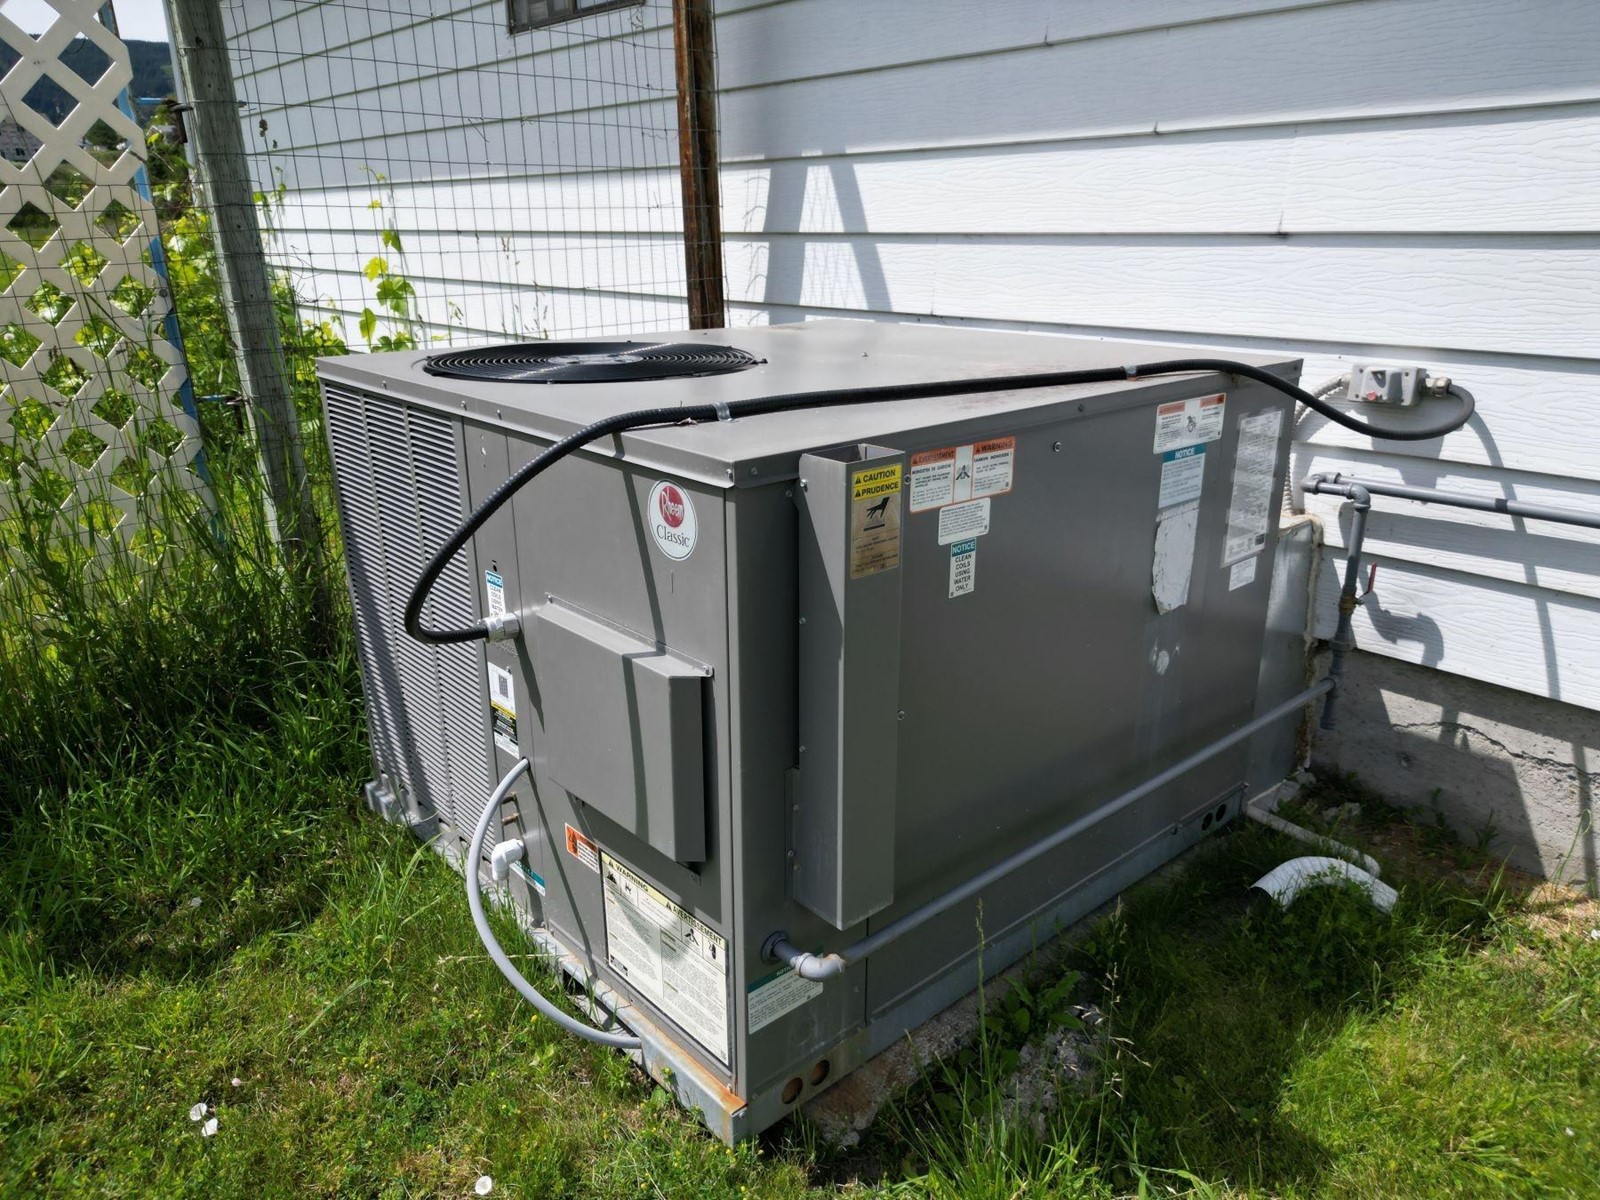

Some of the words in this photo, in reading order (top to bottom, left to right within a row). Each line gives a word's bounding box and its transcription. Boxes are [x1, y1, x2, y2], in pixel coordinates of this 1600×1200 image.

[1174, 447, 1195, 459] NOTICE
[862, 469, 897, 483] CAUTION
[861, 481, 899, 496] PRUDENCE
[661, 486, 685, 522] Rheem
[656, 524, 690, 547] Classic
[952, 541, 975, 554] NOTICE
[954, 554, 972, 563] CLEAN
[955, 561, 971, 570] COILS
[953, 575, 971, 585] WATER
[954, 569, 971, 578] USING
[955, 583, 969, 592] ONLY
[615, 864, 649, 892] WARNING
[673, 906, 722, 945] AVERTISSEMENT
